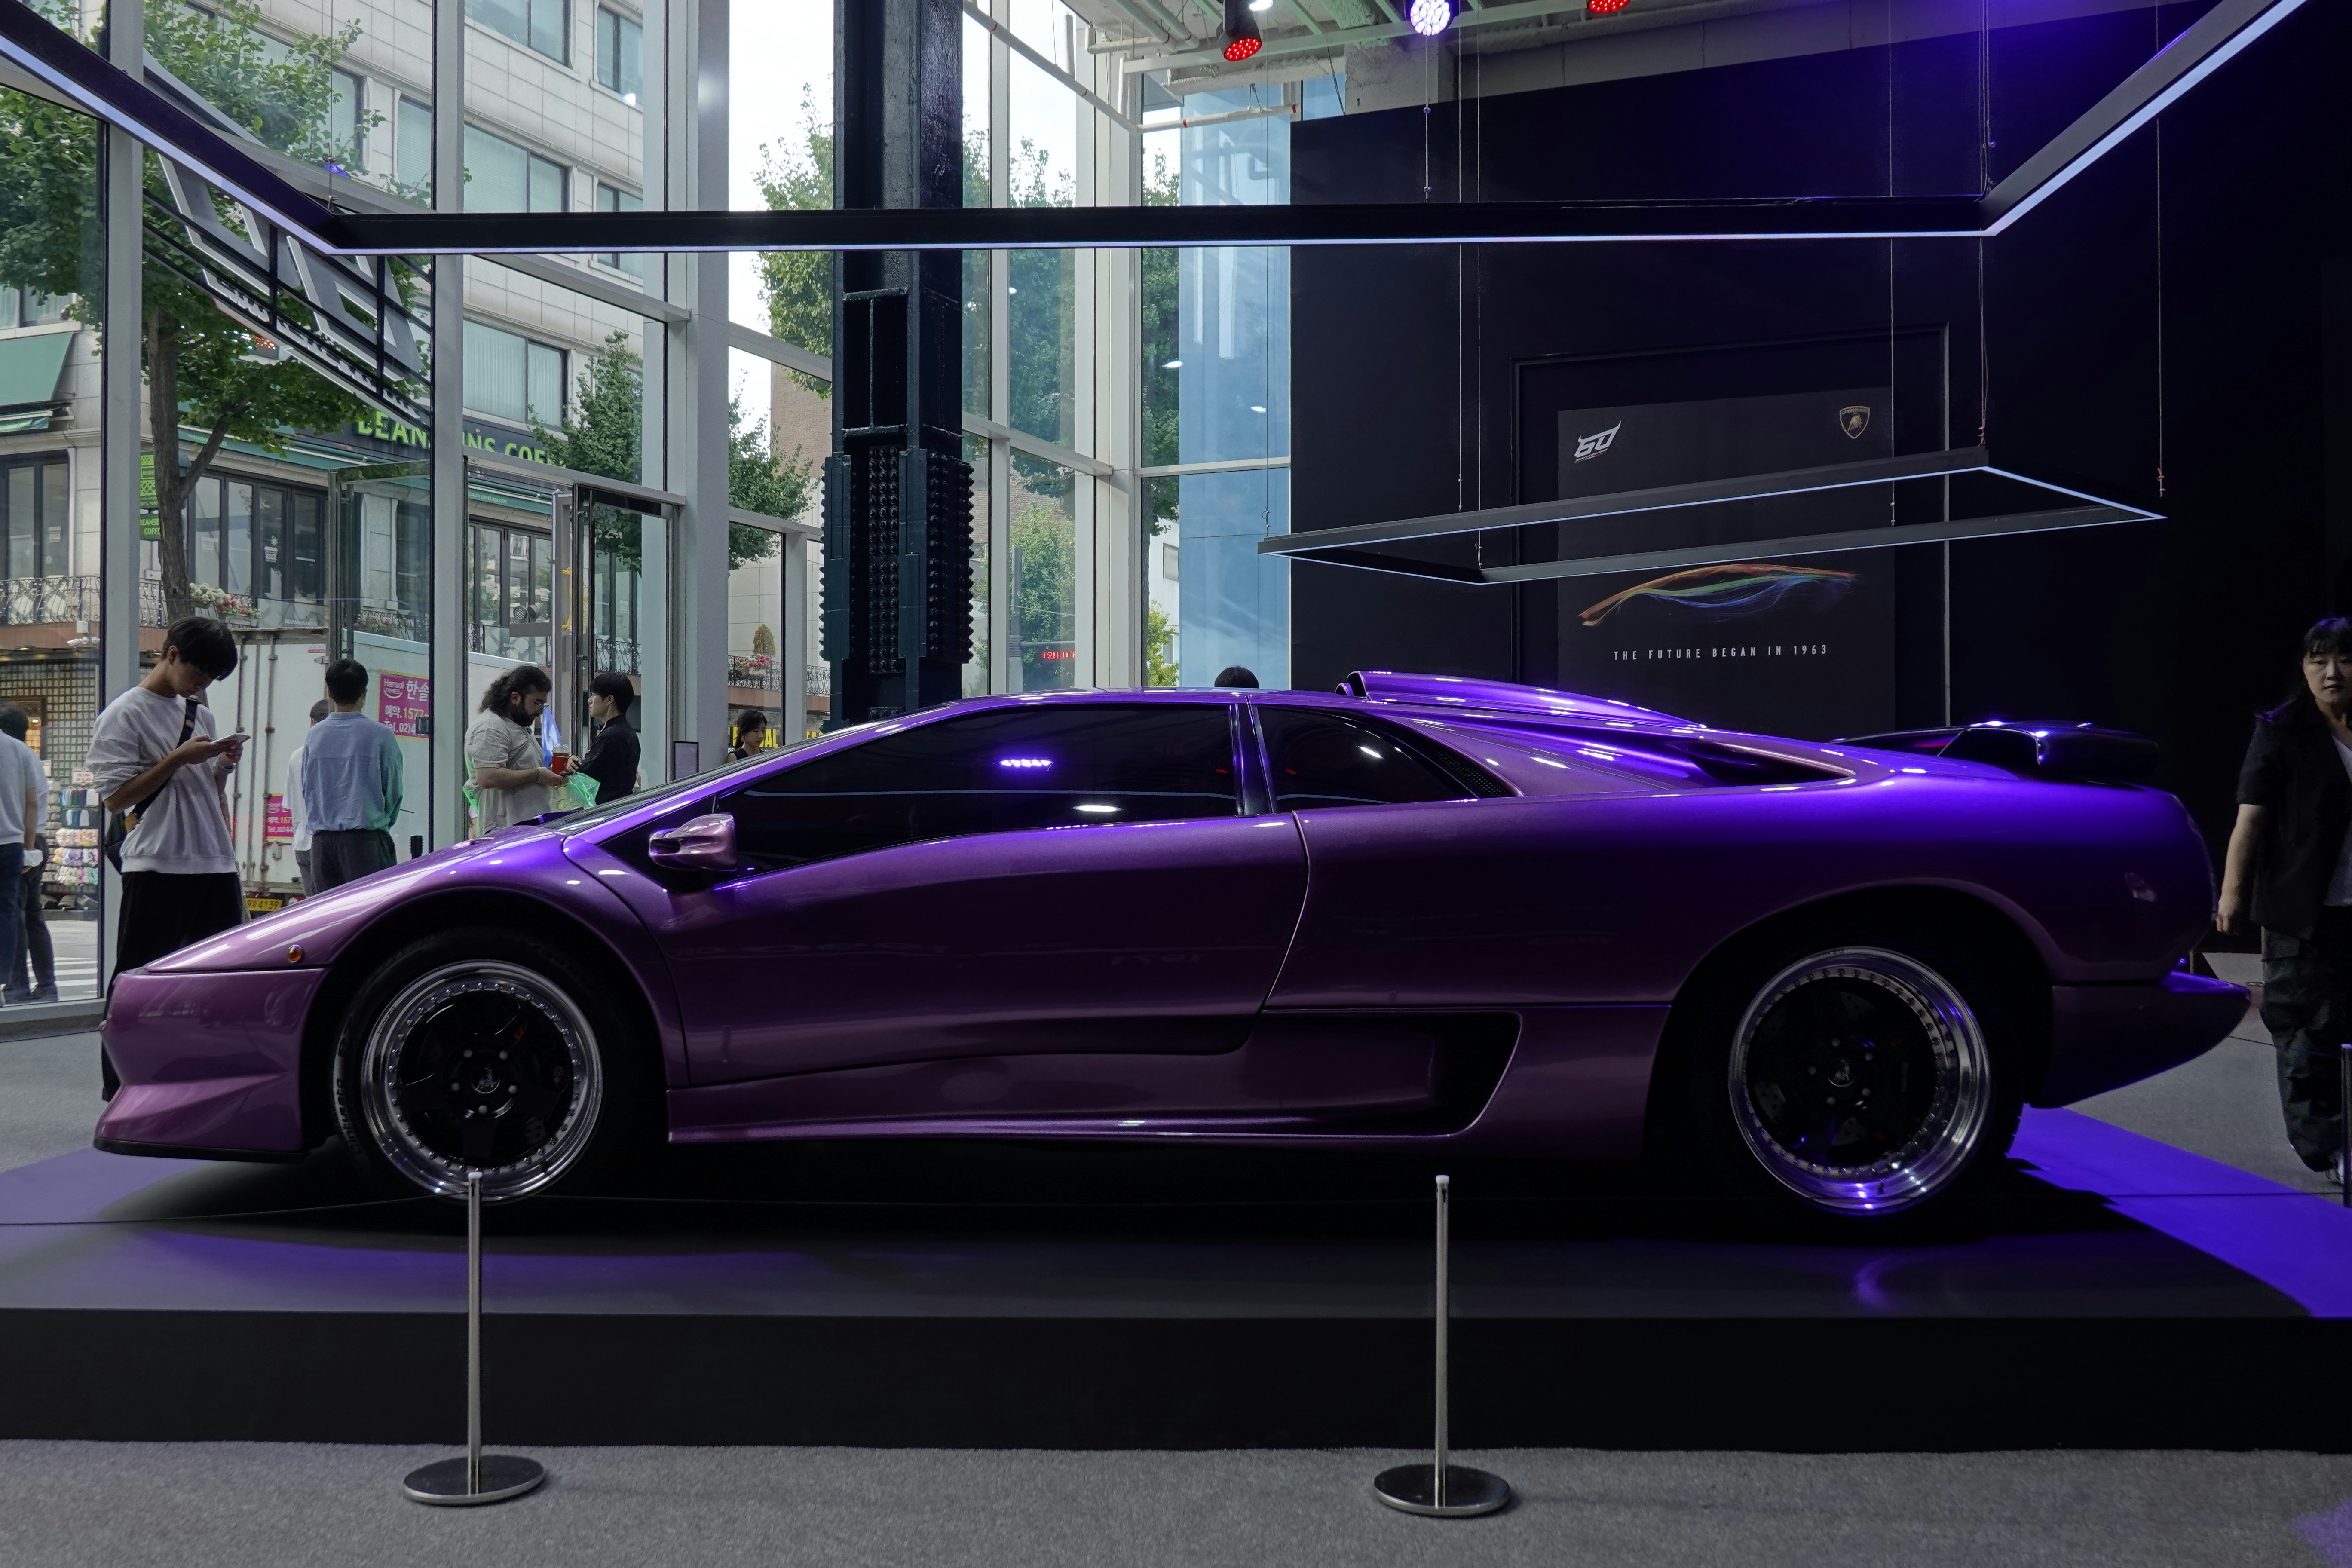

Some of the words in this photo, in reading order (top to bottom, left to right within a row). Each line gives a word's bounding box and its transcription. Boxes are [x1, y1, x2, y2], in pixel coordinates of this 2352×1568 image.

[1574, 421, 1621, 458] 60
[1614, 651, 1637, 660] THE
[1649, 649, 1700, 659] FUTURE
[1713, 647, 1755, 657] BEGAN
[1768, 646, 1781, 655] IN
[1794, 645, 1826, 655] 1963
